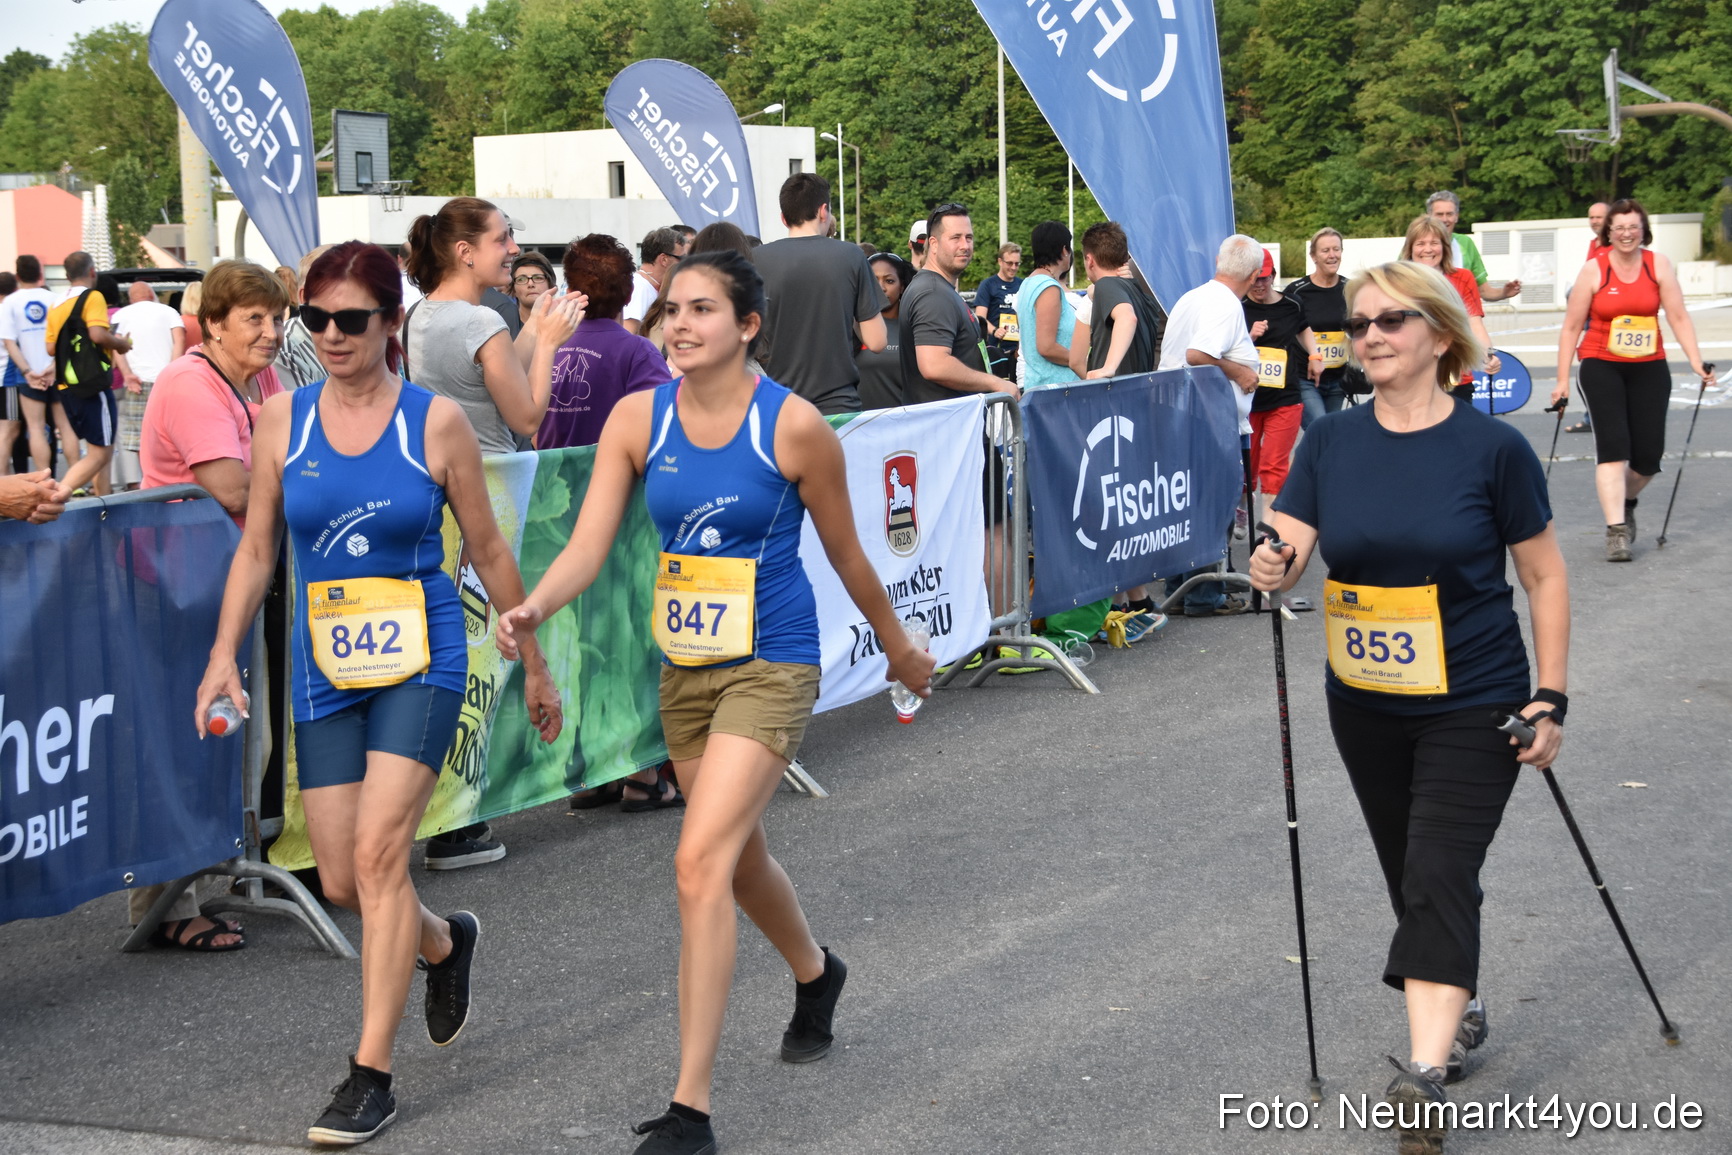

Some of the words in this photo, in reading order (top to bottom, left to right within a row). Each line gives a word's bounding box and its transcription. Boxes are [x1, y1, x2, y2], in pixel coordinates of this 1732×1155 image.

[1615, 332, 1652, 347] 1381
[684, 501, 714, 522] Schick
[715, 495, 739, 506] Bau
[312, 528, 331, 553] Team
[329, 506, 364, 528] Schick
[366, 499, 391, 510] Bau
[893, 530, 913, 548] 1628
[1106, 519, 1191, 563] AUTOMOBILE
[322, 596, 361, 608] firmenlauf
[1336, 599, 1374, 612] firmenlauf
[667, 598, 728, 636] 847
[331, 619, 403, 659] 842
[669, 640, 688, 649] Carina
[688, 643, 724, 653] Nestmeyer
[1345, 626, 1416, 665] 853
[362, 662, 402, 671] Nestmeyer
[1361, 667, 1378, 676] Moni
[1378, 670, 1402, 678] Brandl
